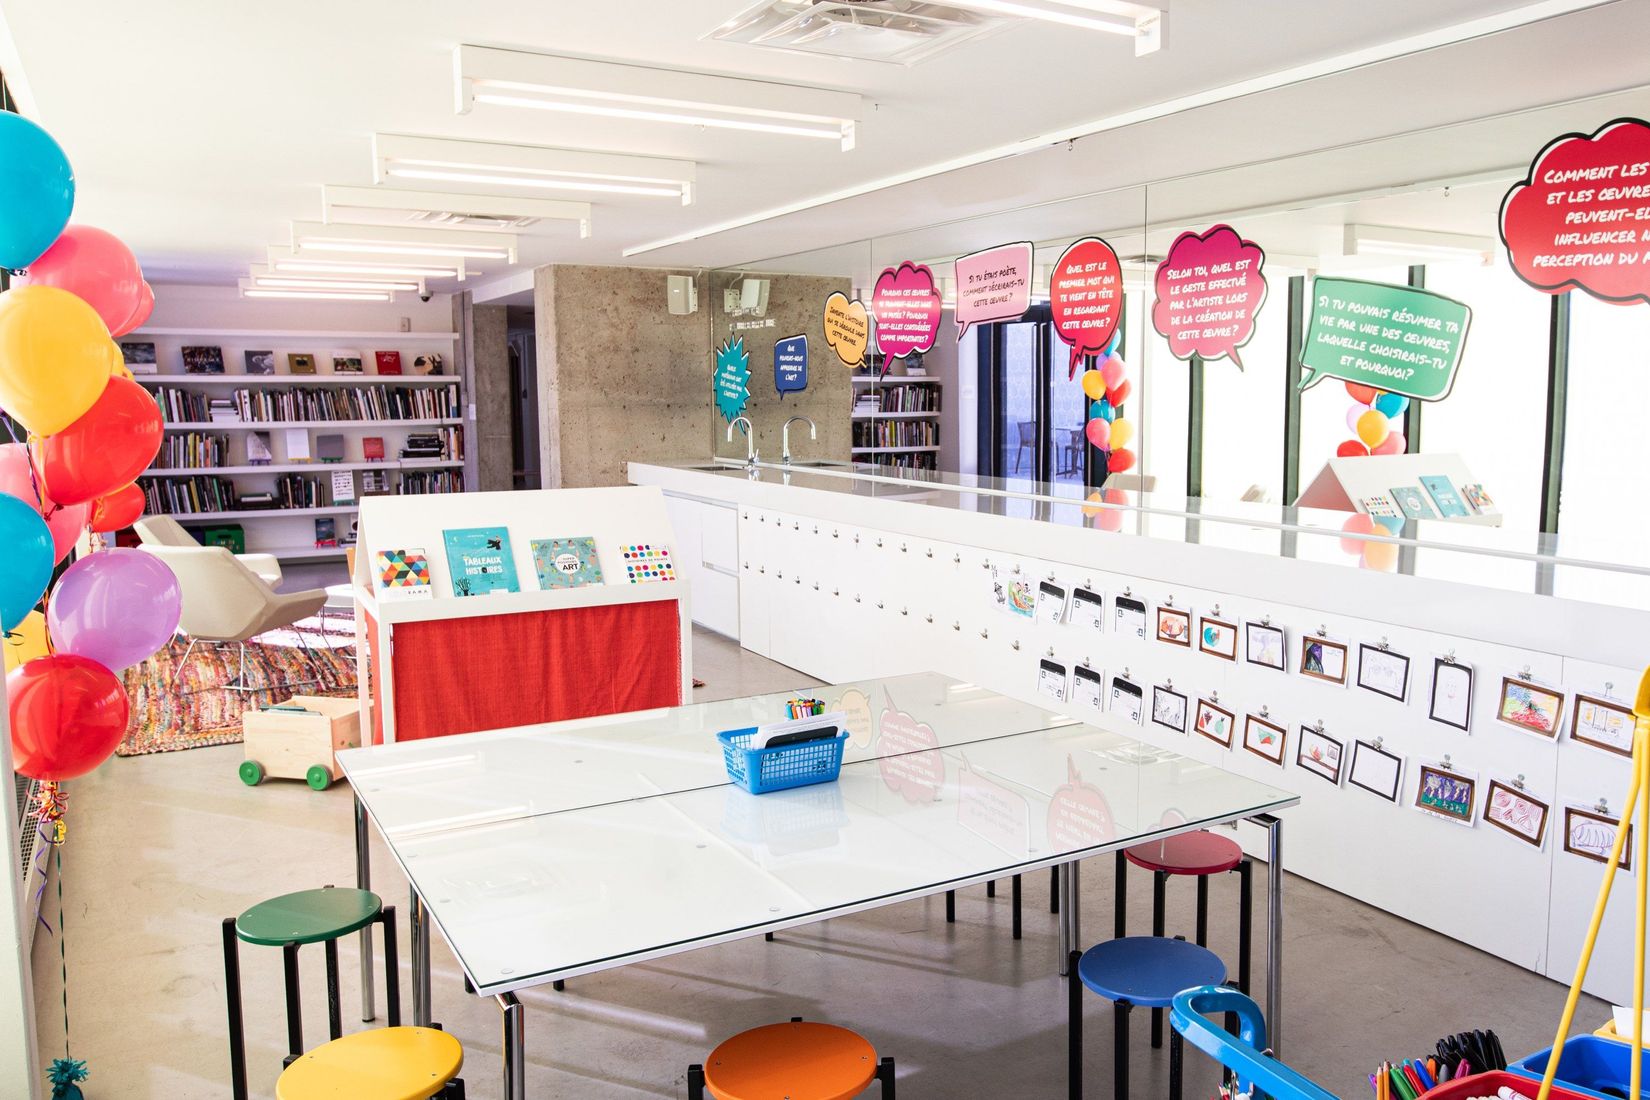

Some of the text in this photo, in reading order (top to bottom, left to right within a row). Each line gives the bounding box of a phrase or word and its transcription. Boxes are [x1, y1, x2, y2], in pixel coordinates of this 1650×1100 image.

[1544, 162, 1650, 184] COMMENT LES
[1546, 192, 1566, 205] ET
[1568, 189, 1595, 203] LES
[1554, 230, 1636, 246] INFLUENCER
[1532, 252, 1614, 267] PERCEPTION
[1618, 252, 1638, 264] DU
[1066, 262, 1107, 274] QUEL EST LE
[1167, 268, 1192, 280] SELON
[1211, 262, 1232, 274] QUEL
[1235, 259, 1251, 270] EST
[968, 275, 974, 283] SI
[984, 270, 998, 280] ÉTAIS
[1059, 275, 1115, 288] PREMIER MOT QUI
[1170, 272, 1246, 295] LE GESTE EFFECTUÉ
[1060, 287, 1114, 302] TE VIENT EN TÊTE
[1170, 292, 1248, 310] PAR L'ARTISTE LORS
[974, 299, 988, 307] CETTE
[1063, 304, 1110, 316] EN REGARDANT
[1171, 309, 1246, 325] DE LA CRÉATION DE
[1318, 296, 1459, 333] SI TU POUVAIS RÉSUMER TA
[1062, 320, 1080, 330] CETTE
[1319, 315, 1334, 326] VIE
[1337, 318, 1356, 331] PAR
[1360, 322, 1379, 335] UNE
[1382, 328, 1402, 340] DES
[1177, 330, 1200, 340] CETTE
[1317, 333, 1447, 370] LAQUELLE CHOISIRAIS-TU
[1340, 356, 1414, 380] ET POURQUOI?
[463, 556, 502, 566] TABLEAUX
[466, 566, 503, 575] HISTOIRES
